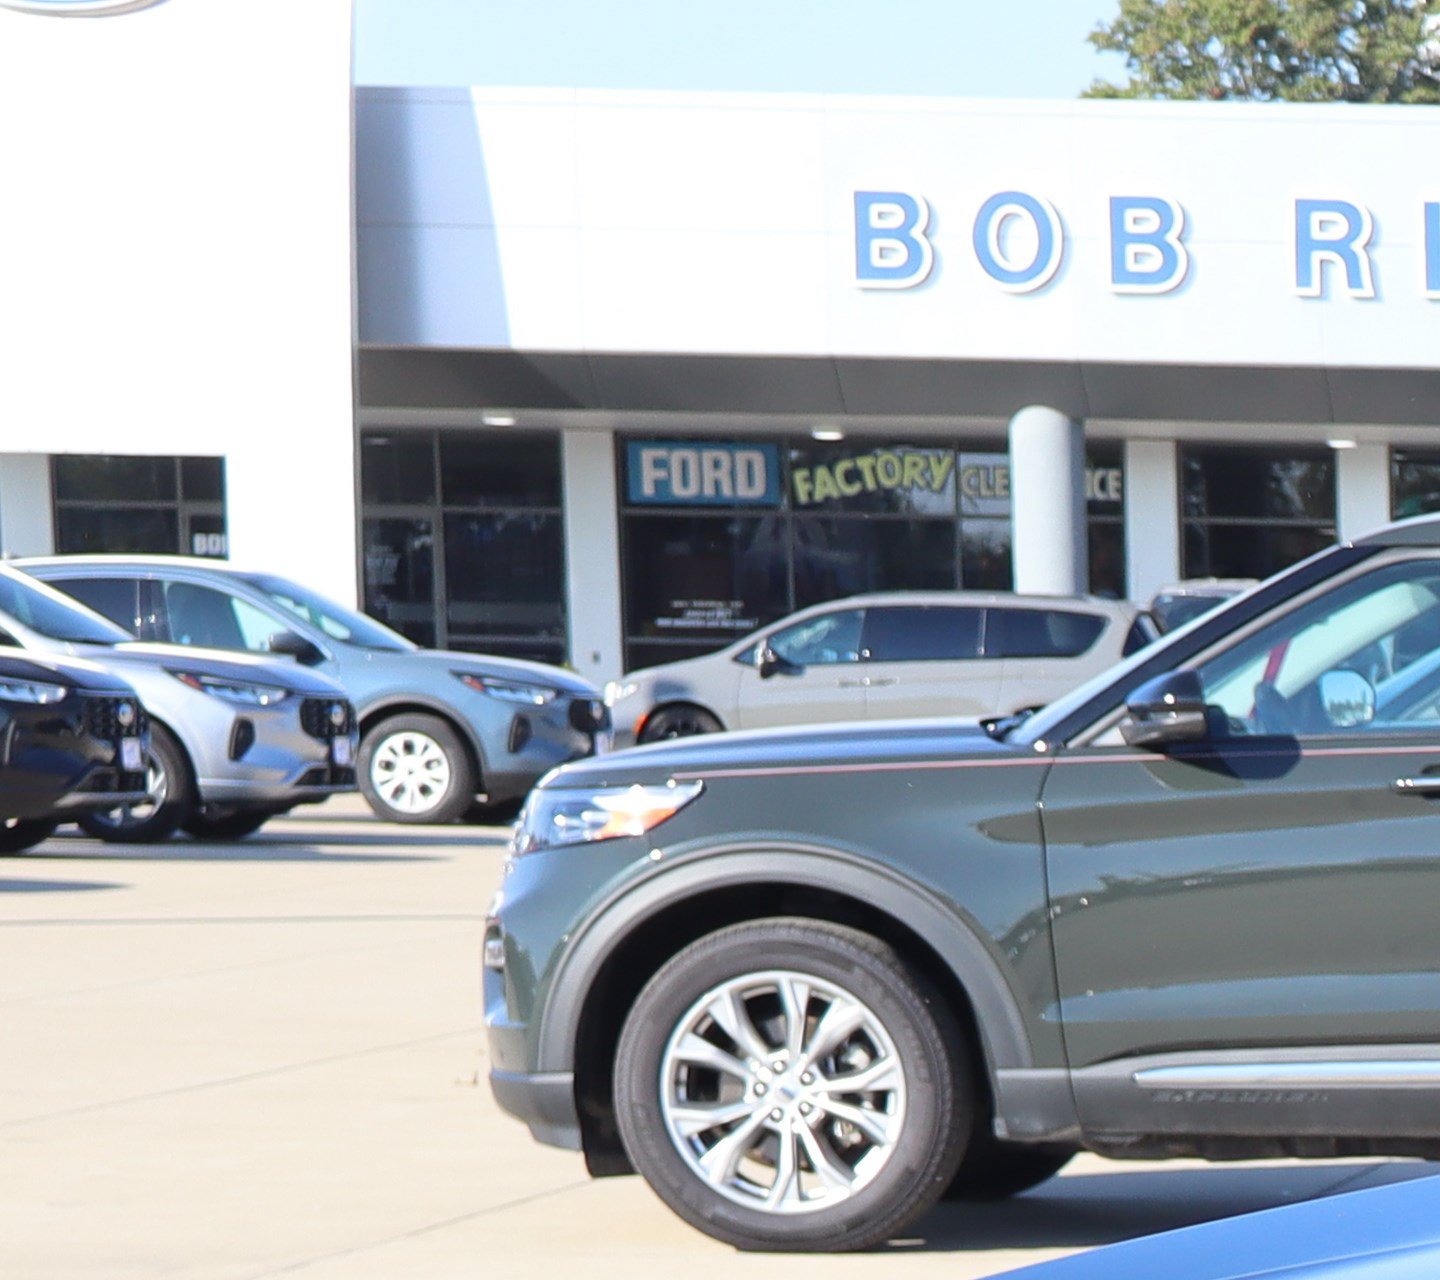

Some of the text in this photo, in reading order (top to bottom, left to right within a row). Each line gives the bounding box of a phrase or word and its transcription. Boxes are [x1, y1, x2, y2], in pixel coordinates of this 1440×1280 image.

[853, 189, 1192, 294] BOB
[640, 447, 768, 497] FORD
[792, 451, 957, 504] FACTORY
[193, 532, 228, 556] BO
